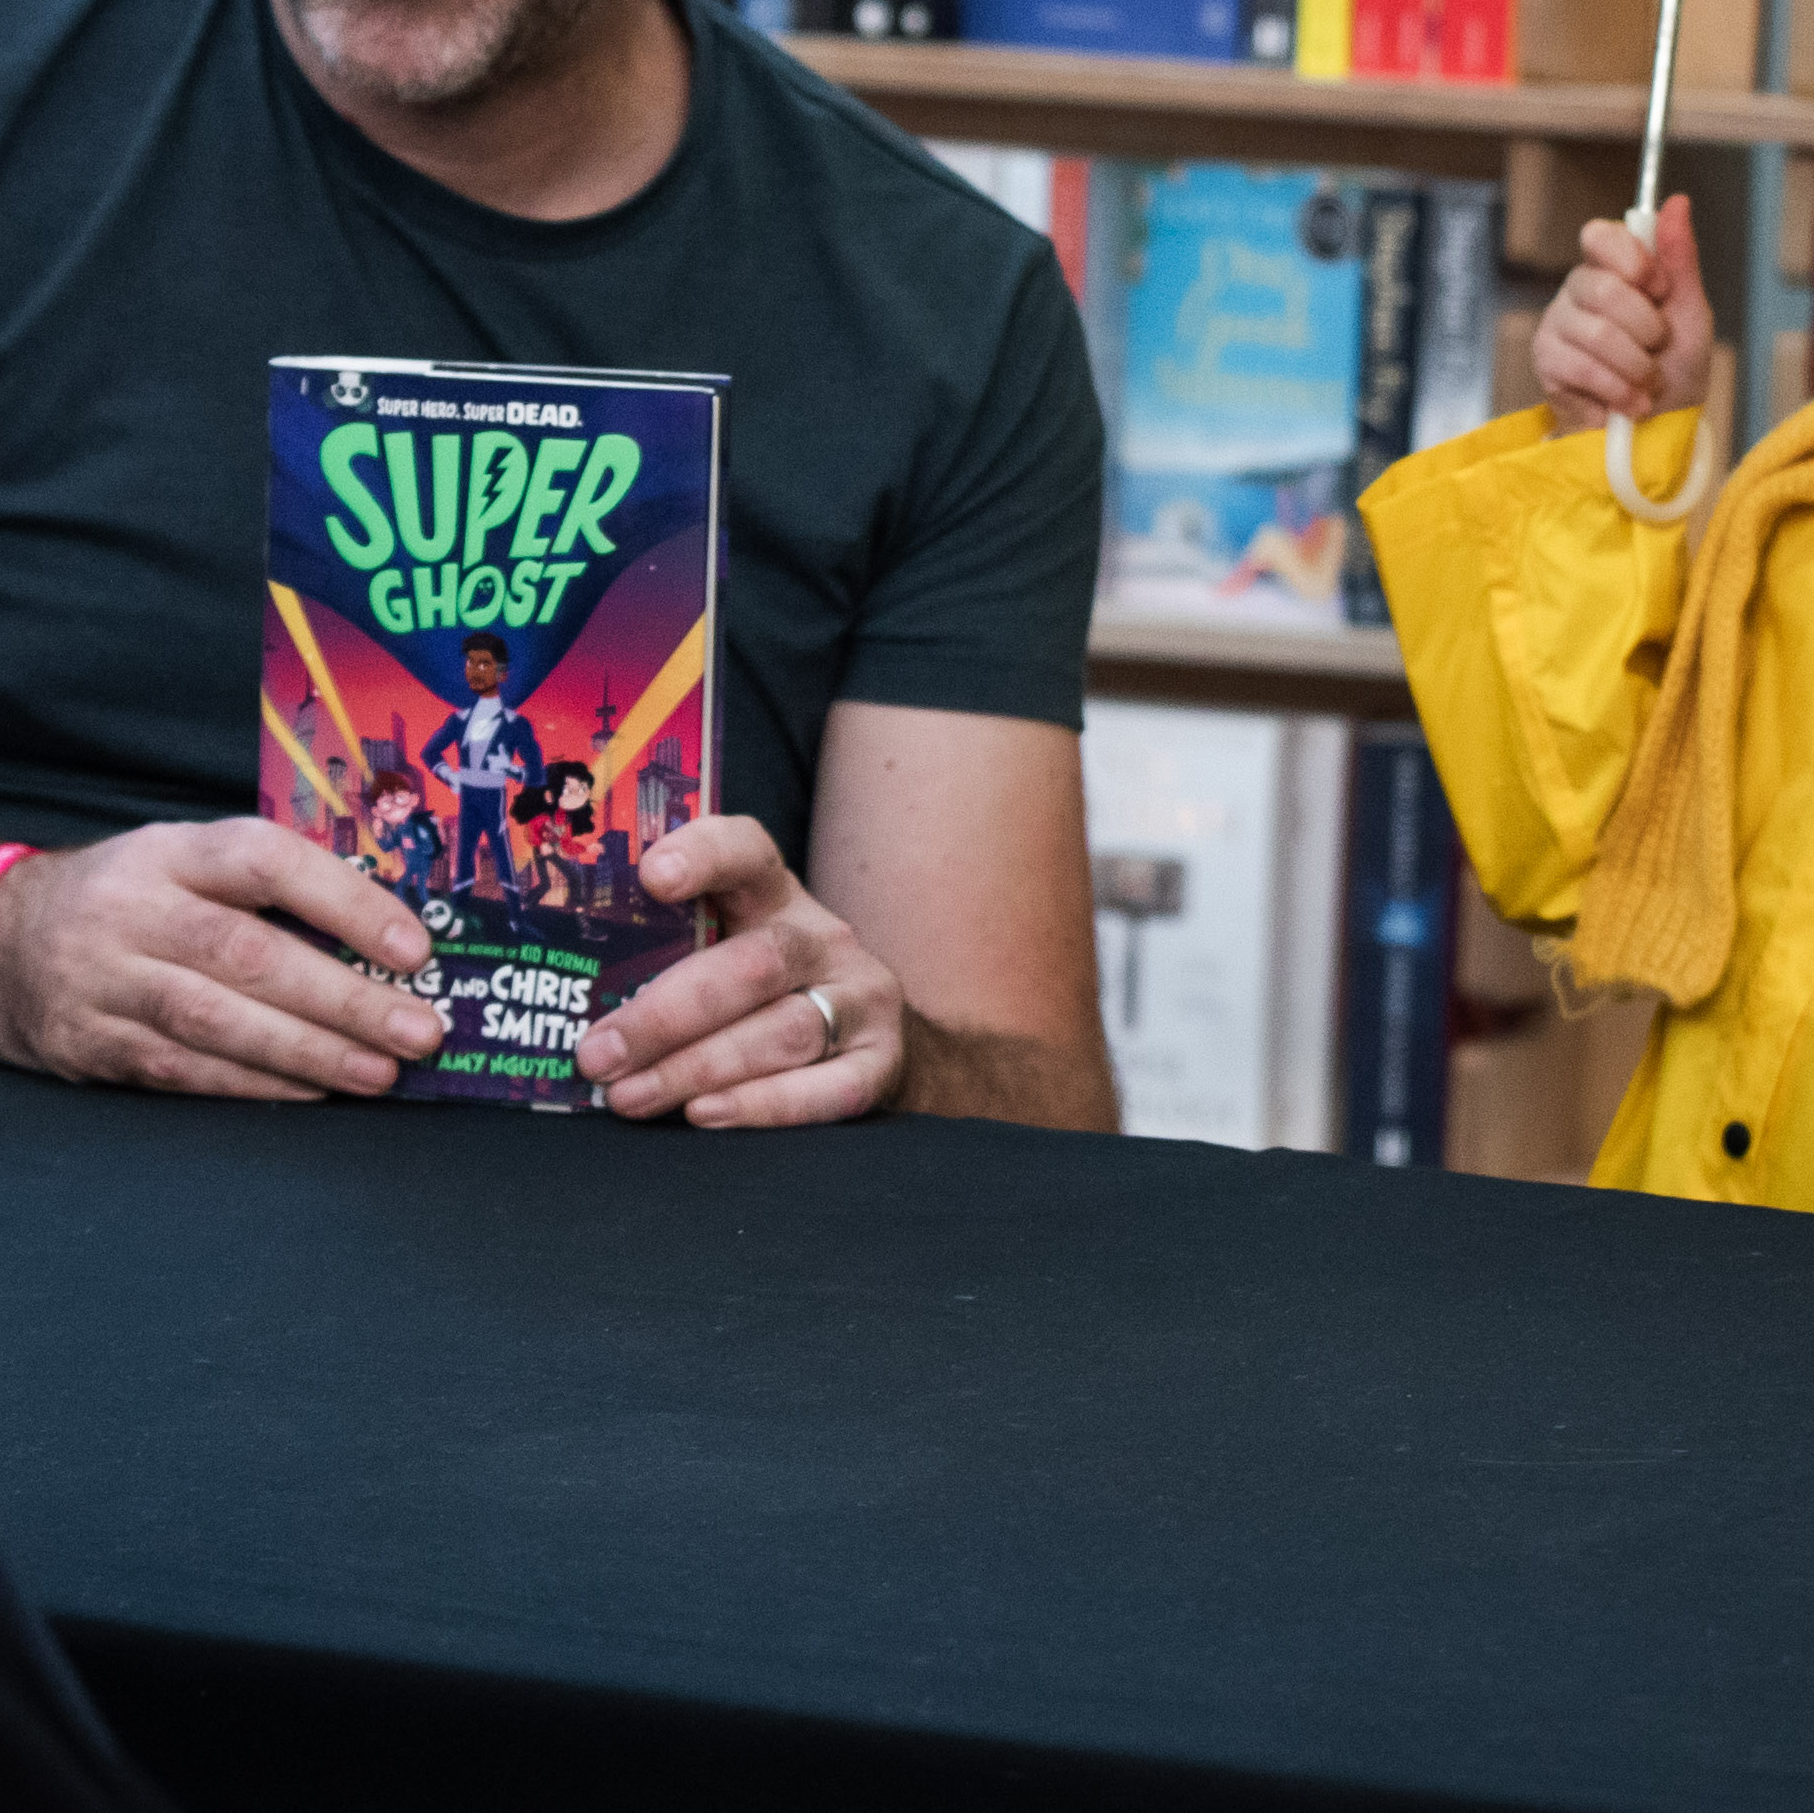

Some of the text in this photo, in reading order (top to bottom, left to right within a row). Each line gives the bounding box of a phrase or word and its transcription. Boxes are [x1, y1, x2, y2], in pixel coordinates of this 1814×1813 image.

[377, 396, 418, 418] SUPER
[463, 402, 505, 423] SUPER
[506, 402, 583, 428] DEAD.
[319, 421, 642, 571] SUPER
[368, 559, 587, 634] GHOST
[519, 943, 544, 964] KID
[545, 948, 602, 978] NORMAL
[449, 976, 489, 999] AND
[490, 963, 593, 1014] CHRIS
[480, 1002, 592, 1052] SMITH
[437, 1051, 575, 1080] AMY NGUYEN
